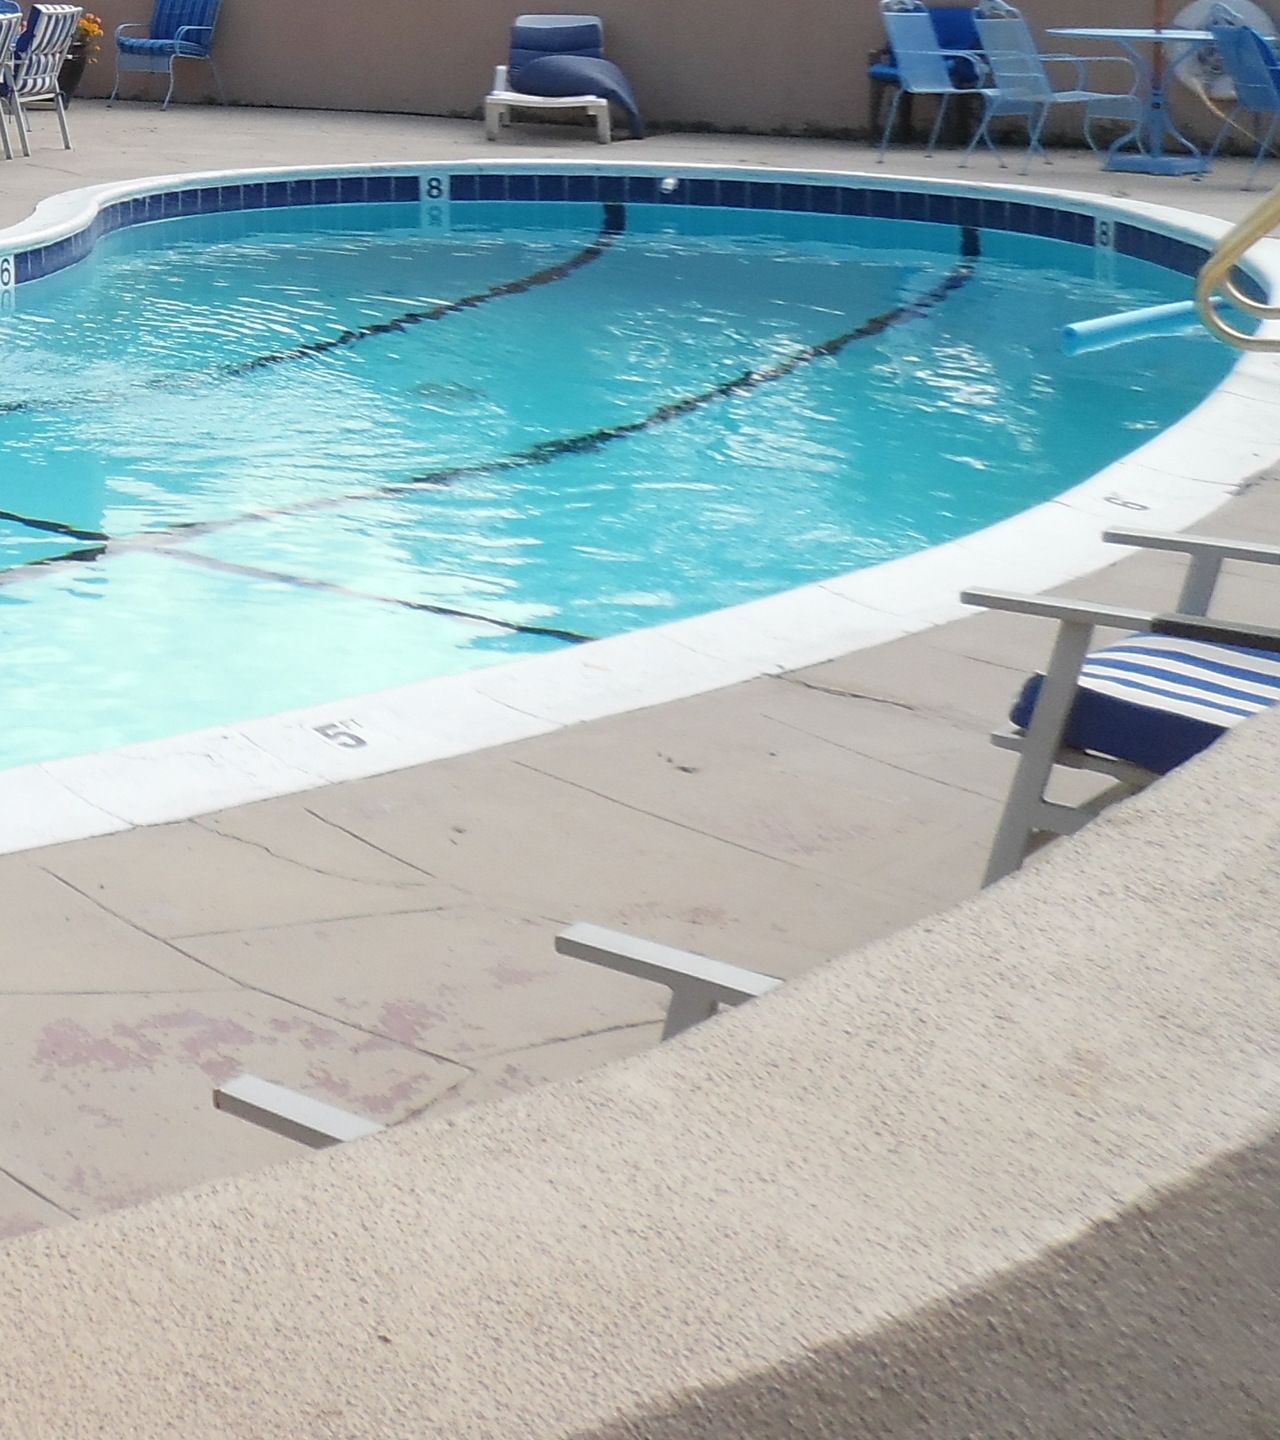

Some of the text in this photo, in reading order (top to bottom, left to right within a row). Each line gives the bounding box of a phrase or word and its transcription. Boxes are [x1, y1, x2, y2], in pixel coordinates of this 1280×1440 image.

[426, 177, 443, 199] 8
[0, 257, 11, 287] 6
[312, 723, 368, 749] 5
